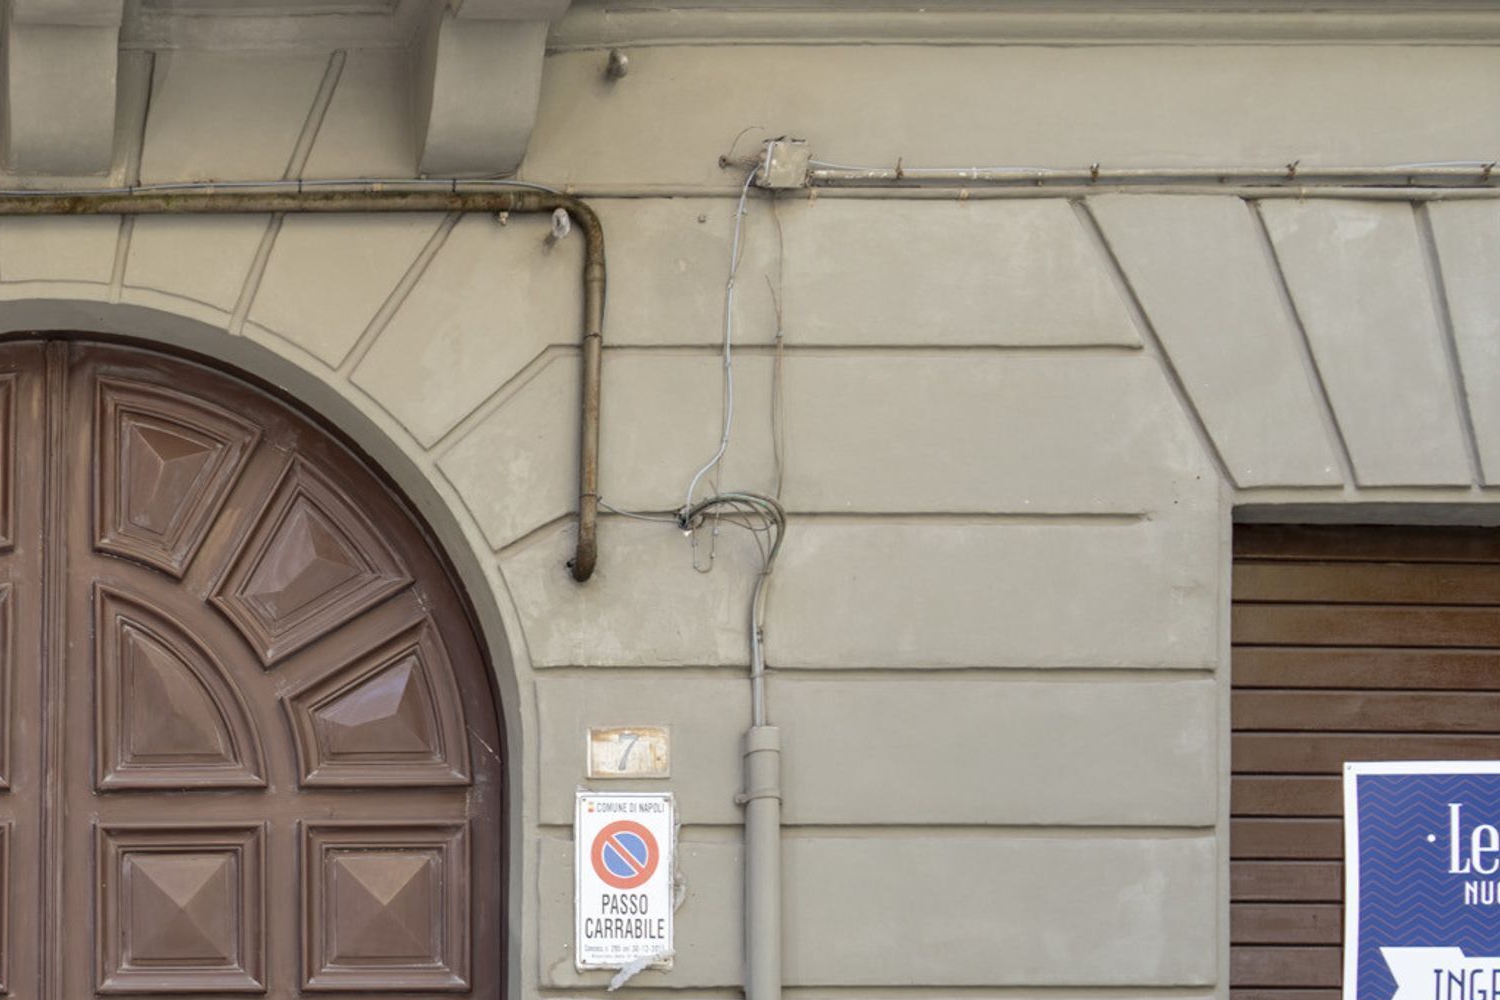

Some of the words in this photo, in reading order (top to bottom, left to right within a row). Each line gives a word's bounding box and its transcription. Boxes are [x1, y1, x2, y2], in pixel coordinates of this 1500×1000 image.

[617, 733, 639, 770] 7
[596, 802, 628, 813] COMUNE
[629, 802, 637, 813] DI
[639, 802, 665, 813] NAPOLI
[601, 894, 649, 915] PASSO
[585, 918, 665, 939] CARRABILE
